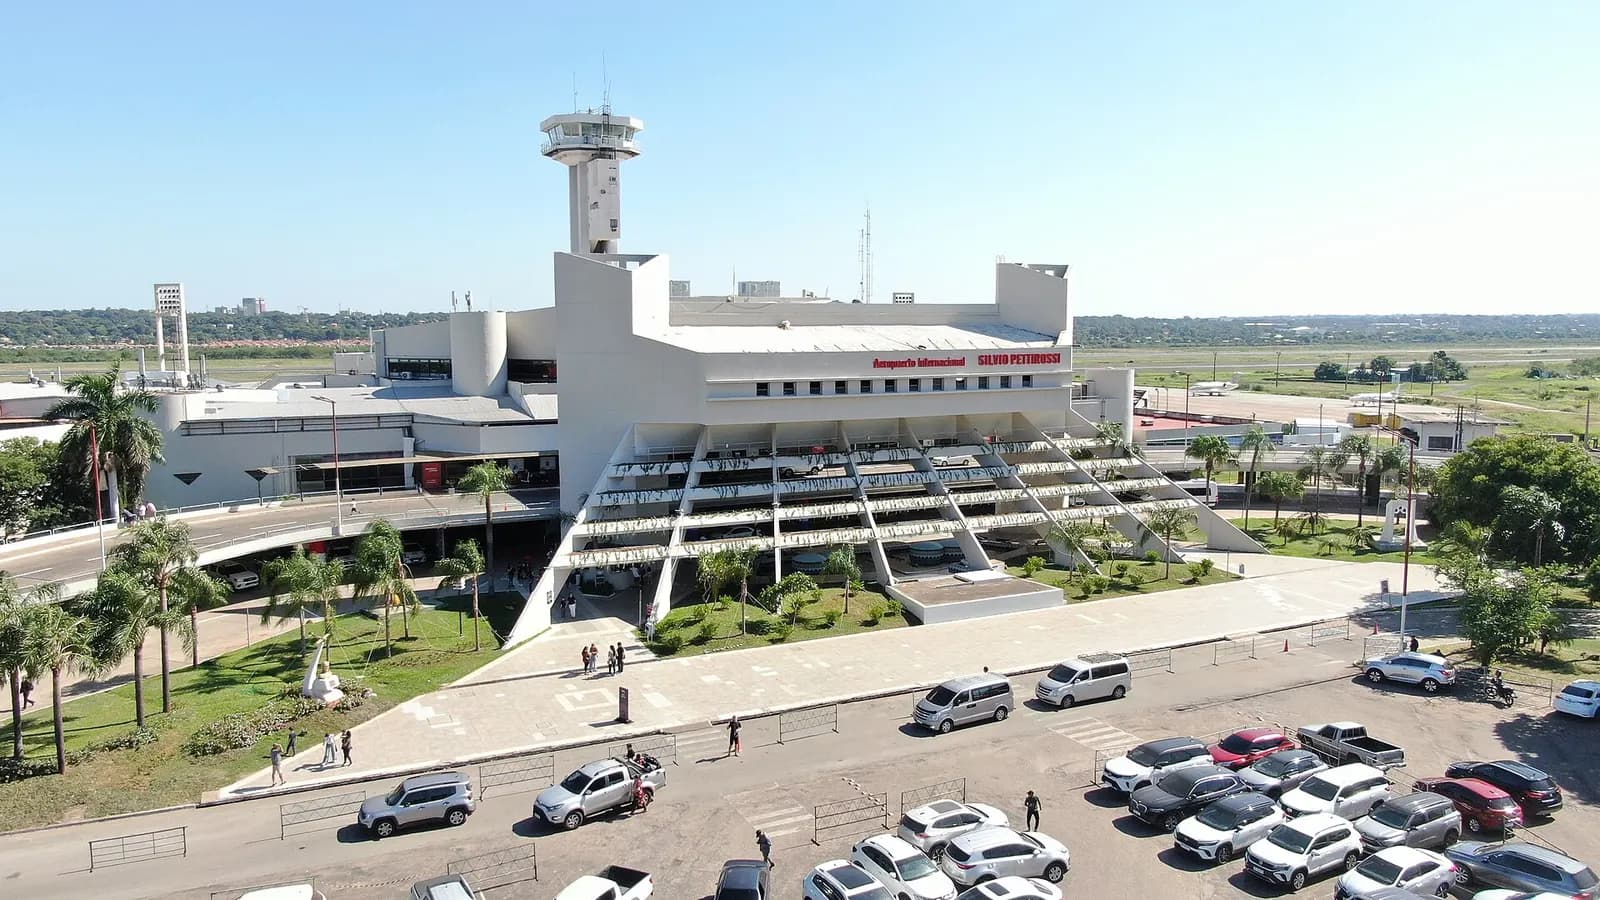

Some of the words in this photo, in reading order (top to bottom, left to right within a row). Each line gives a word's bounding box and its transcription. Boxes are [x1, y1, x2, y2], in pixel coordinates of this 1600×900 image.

[873, 358, 916, 370] Aeropuerto
[918, 357, 965, 367] Internacional
[978, 354, 1008, 366] SILVIO
[1010, 353, 1061, 365] PETTIROSSI
